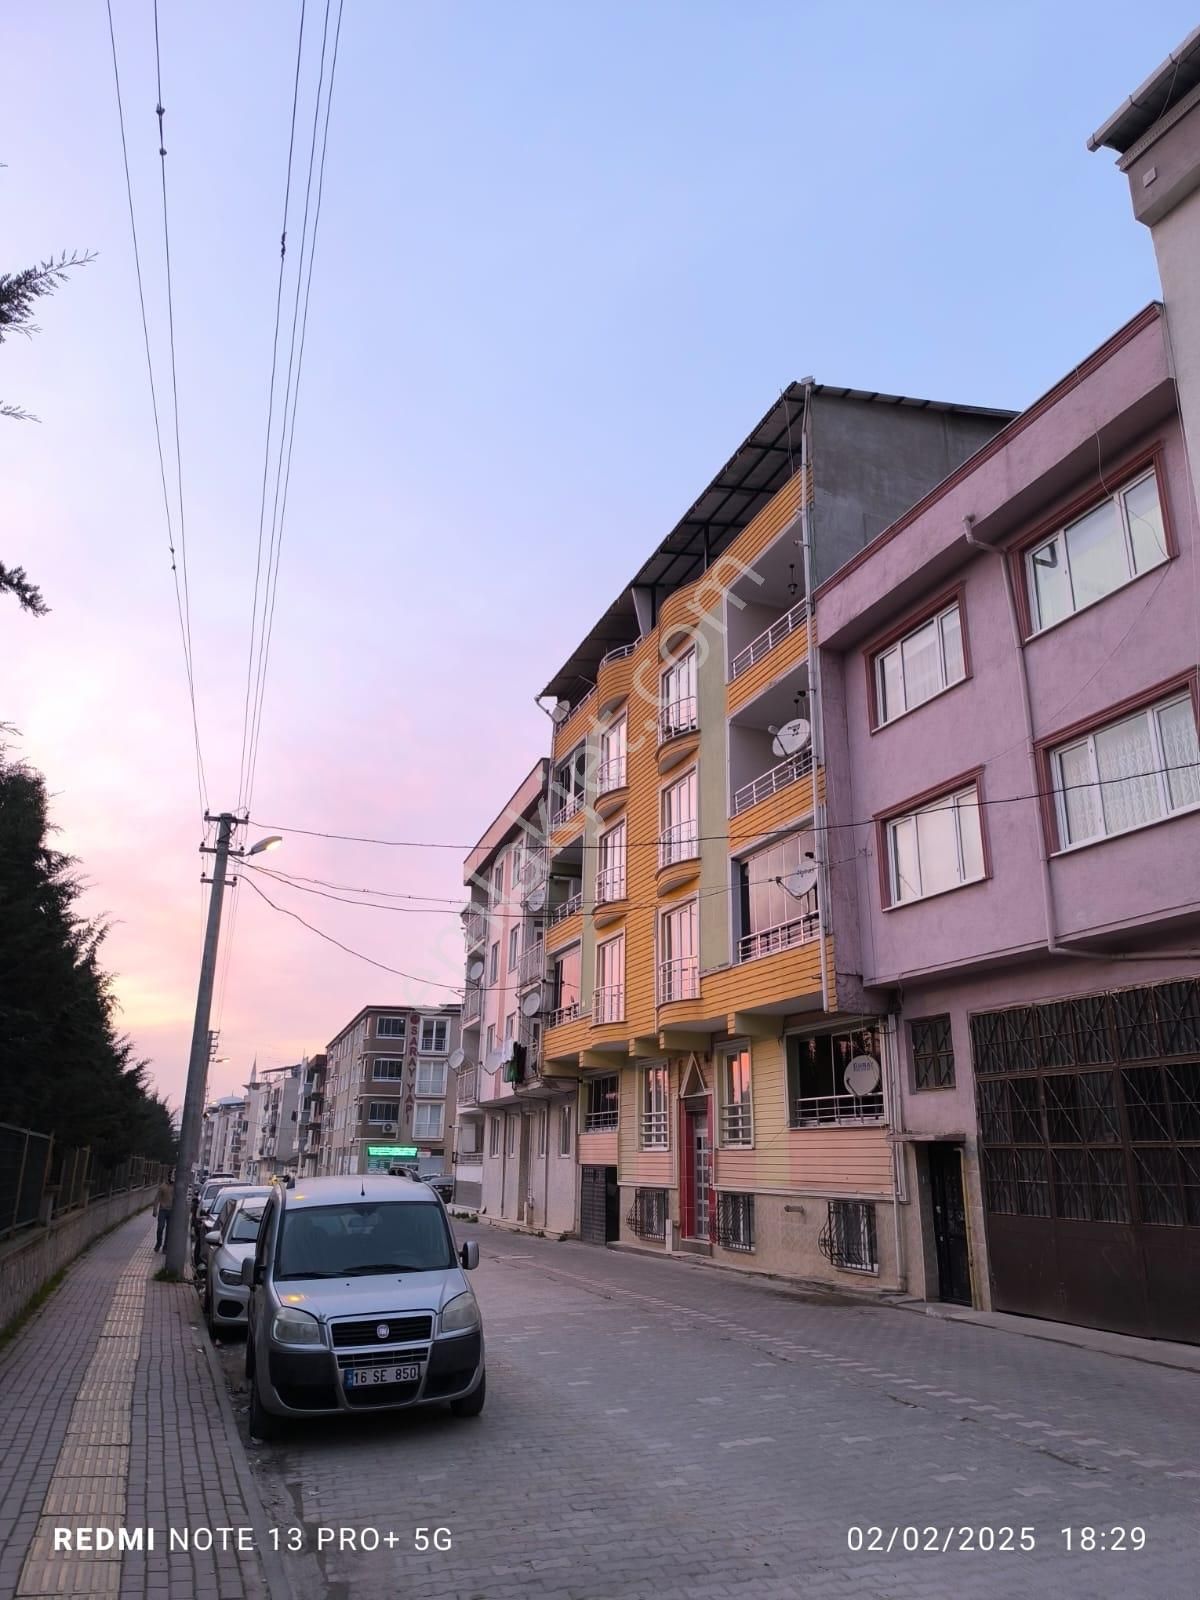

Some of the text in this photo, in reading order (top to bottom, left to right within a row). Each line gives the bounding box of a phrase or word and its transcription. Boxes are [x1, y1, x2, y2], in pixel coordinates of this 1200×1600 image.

[404, 1026, 418, 1125] SARAY YAPI
[354, 1367, 417, 1385] 16 SE 850
